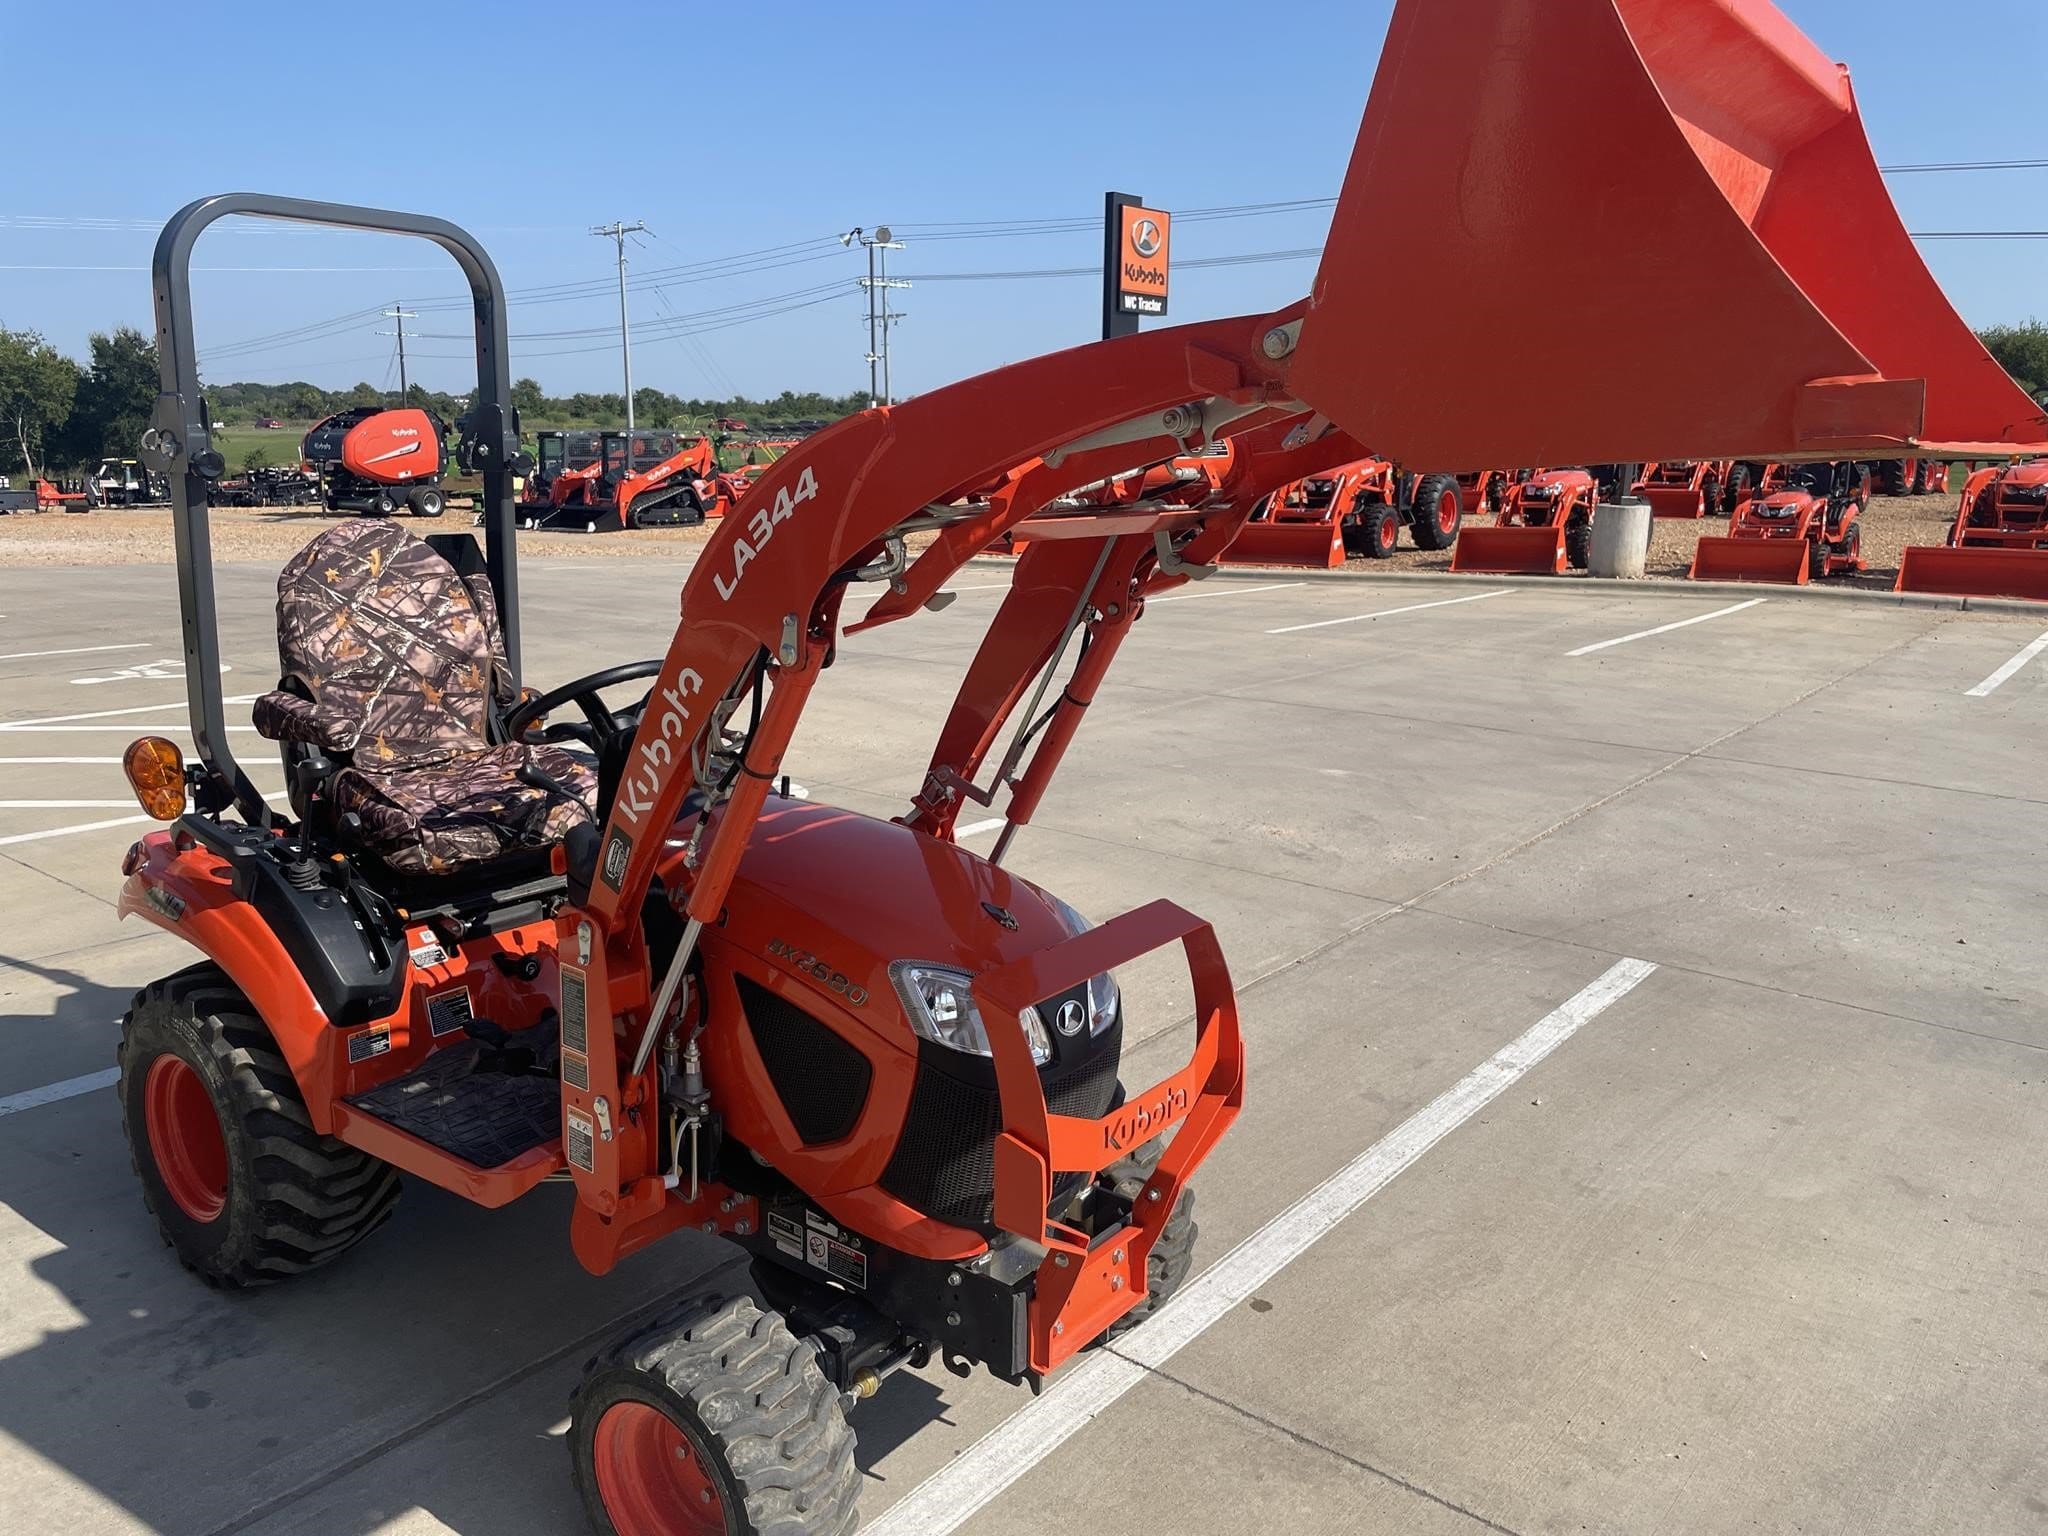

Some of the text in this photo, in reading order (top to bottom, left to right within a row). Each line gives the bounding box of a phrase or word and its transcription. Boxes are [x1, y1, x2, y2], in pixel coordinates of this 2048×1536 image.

[1124, 295, 1162, 312] WC Tractor
[1125, 263, 1165, 285] Kubota
[712, 465, 819, 601] LA344
[618, 666, 704, 824] Kubota
[1104, 1087, 1188, 1150] Kubota
